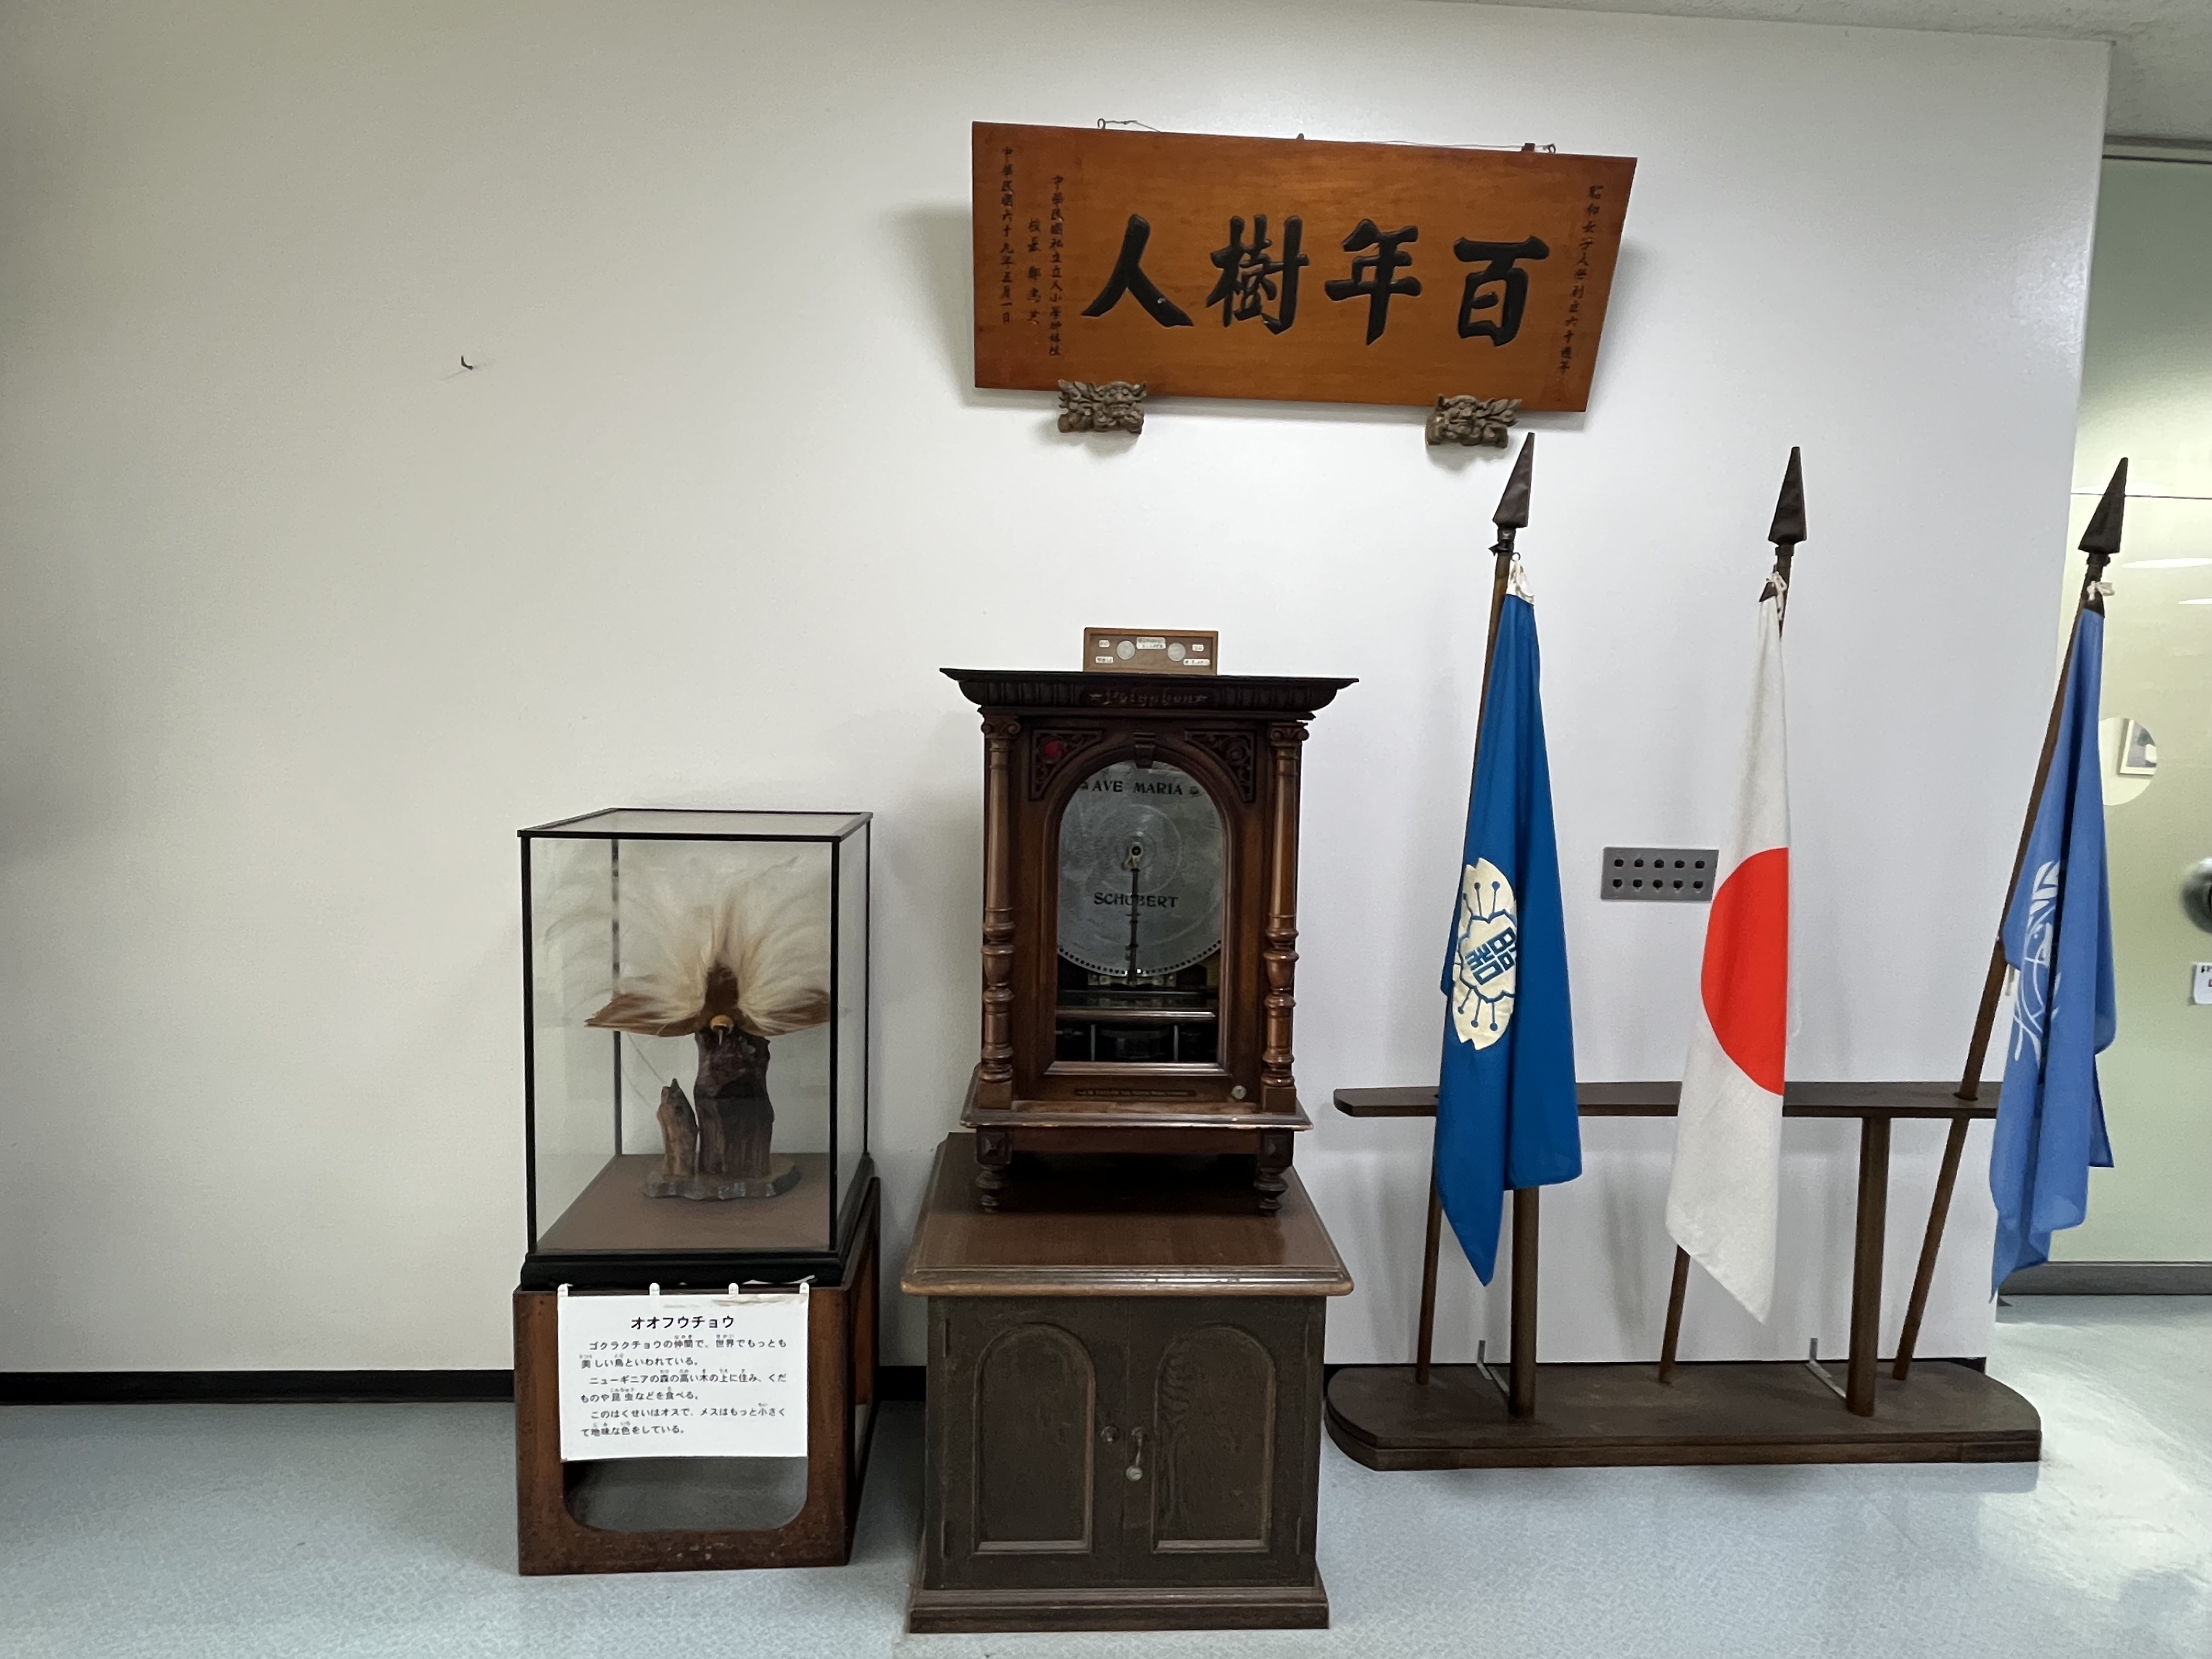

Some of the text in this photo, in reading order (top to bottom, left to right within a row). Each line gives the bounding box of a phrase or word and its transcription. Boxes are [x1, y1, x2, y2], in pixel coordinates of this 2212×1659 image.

[1081, 213, 1550, 347] 百年樹人
[1092, 780, 1183, 795] AVE MARIA
[631, 1315, 735, 1330] オオフウチョウ
